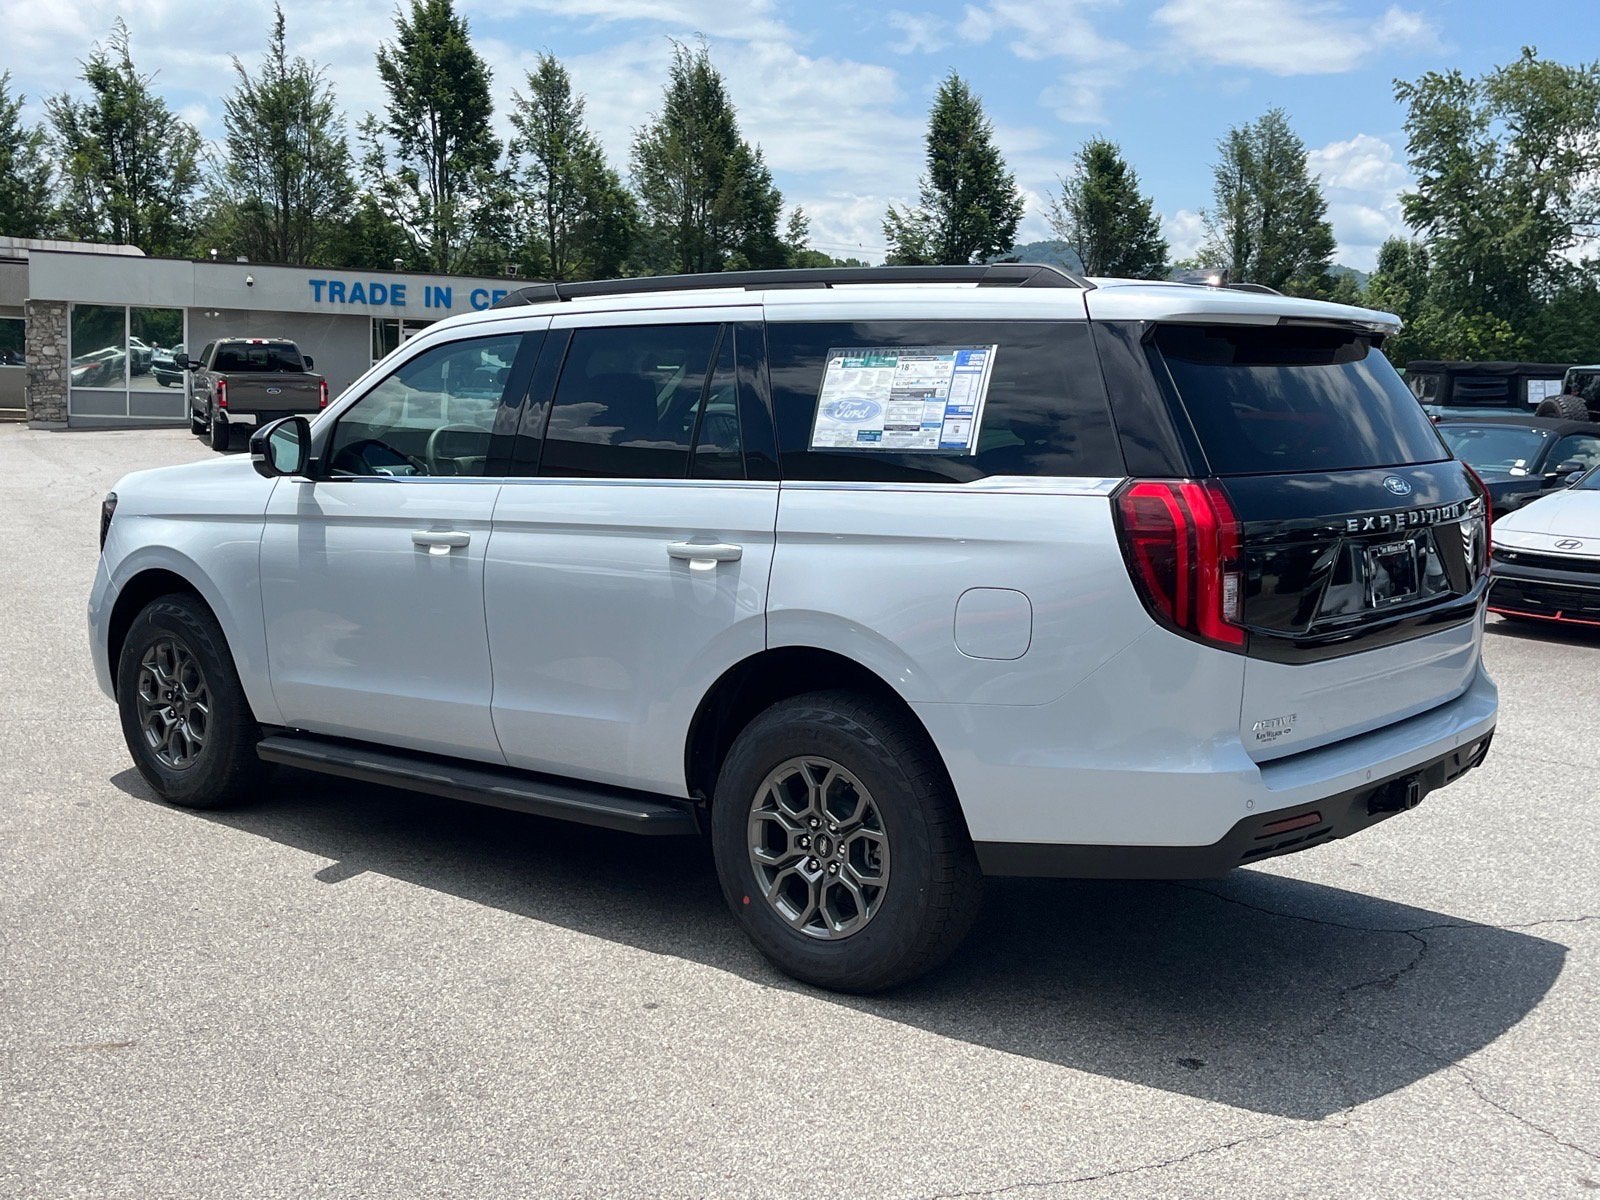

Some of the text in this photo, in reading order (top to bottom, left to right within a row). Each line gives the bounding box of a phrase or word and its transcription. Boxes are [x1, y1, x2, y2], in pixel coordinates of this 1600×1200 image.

[309, 279, 407, 306] TRADE
[425, 286, 452, 309] IN
[1346, 505, 1460, 533] EXPEDITION
[1252, 713, 1297, 732] ACTIVE
